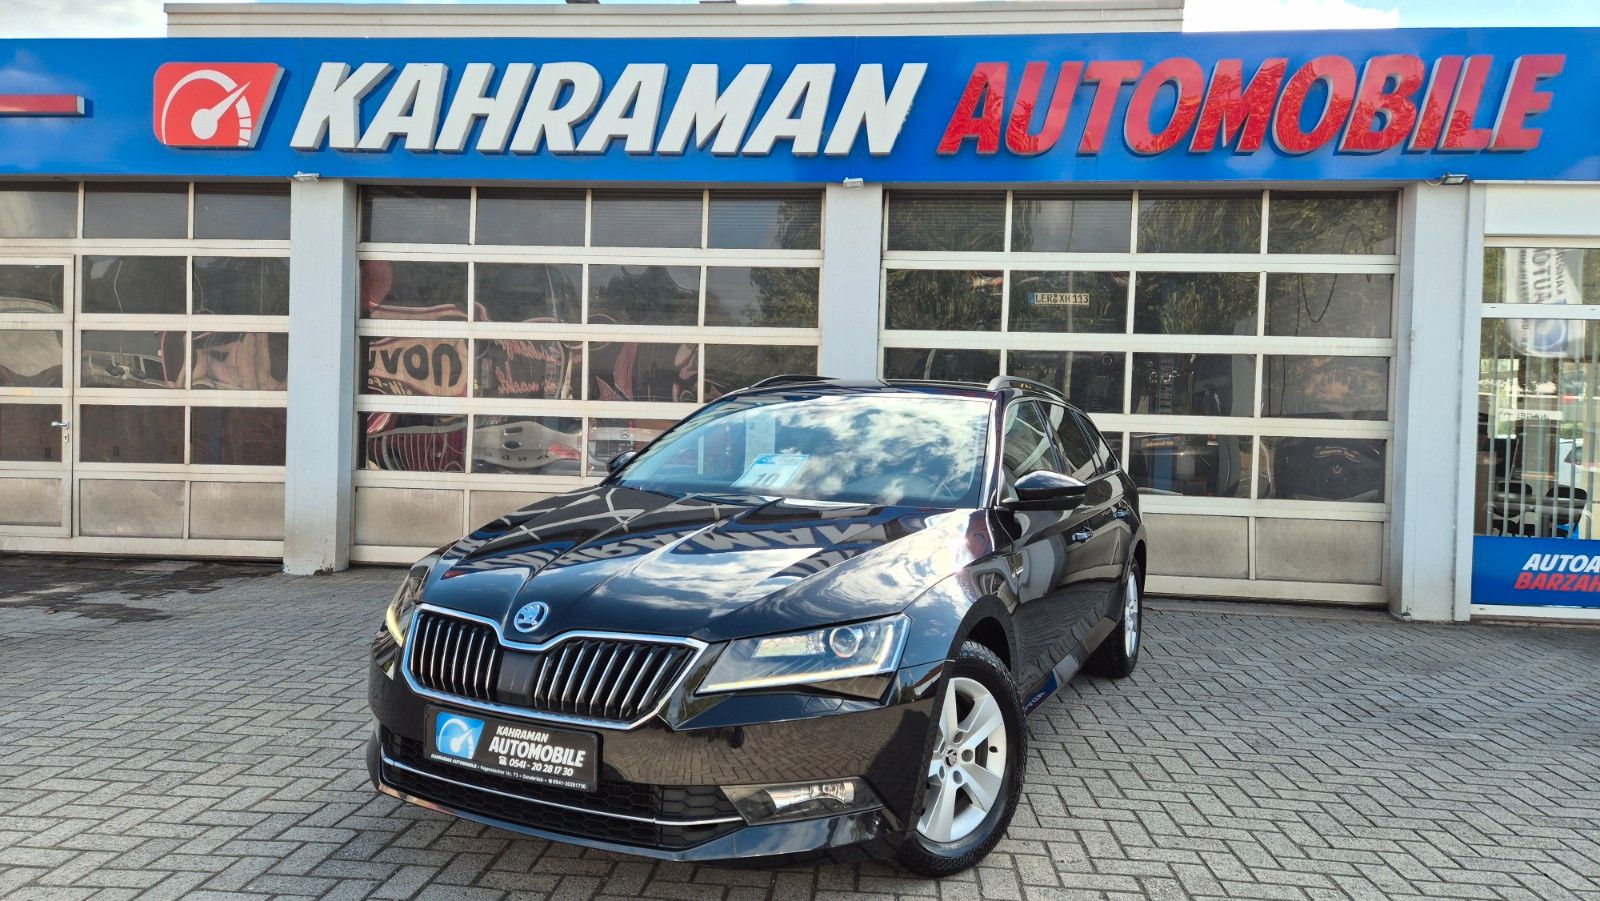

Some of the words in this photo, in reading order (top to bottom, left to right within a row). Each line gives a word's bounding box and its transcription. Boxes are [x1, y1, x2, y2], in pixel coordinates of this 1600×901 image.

[290, 62, 928, 155] KAHRAMAN
[936, 54, 1567, 156] AUTOMOBILE
[1522, 553, 1600, 573] AUTOA
[496, 725, 549, 743] KAHRAMAN
[488, 737, 586, 768] AUTOMOBILE
[509, 758, 526, 768] 0541
[531, 762, 542, 771] 20
[543, 764, 553, 773] 28
[554, 766, 562, 774] 17
[562, 767, 574, 776] 30
